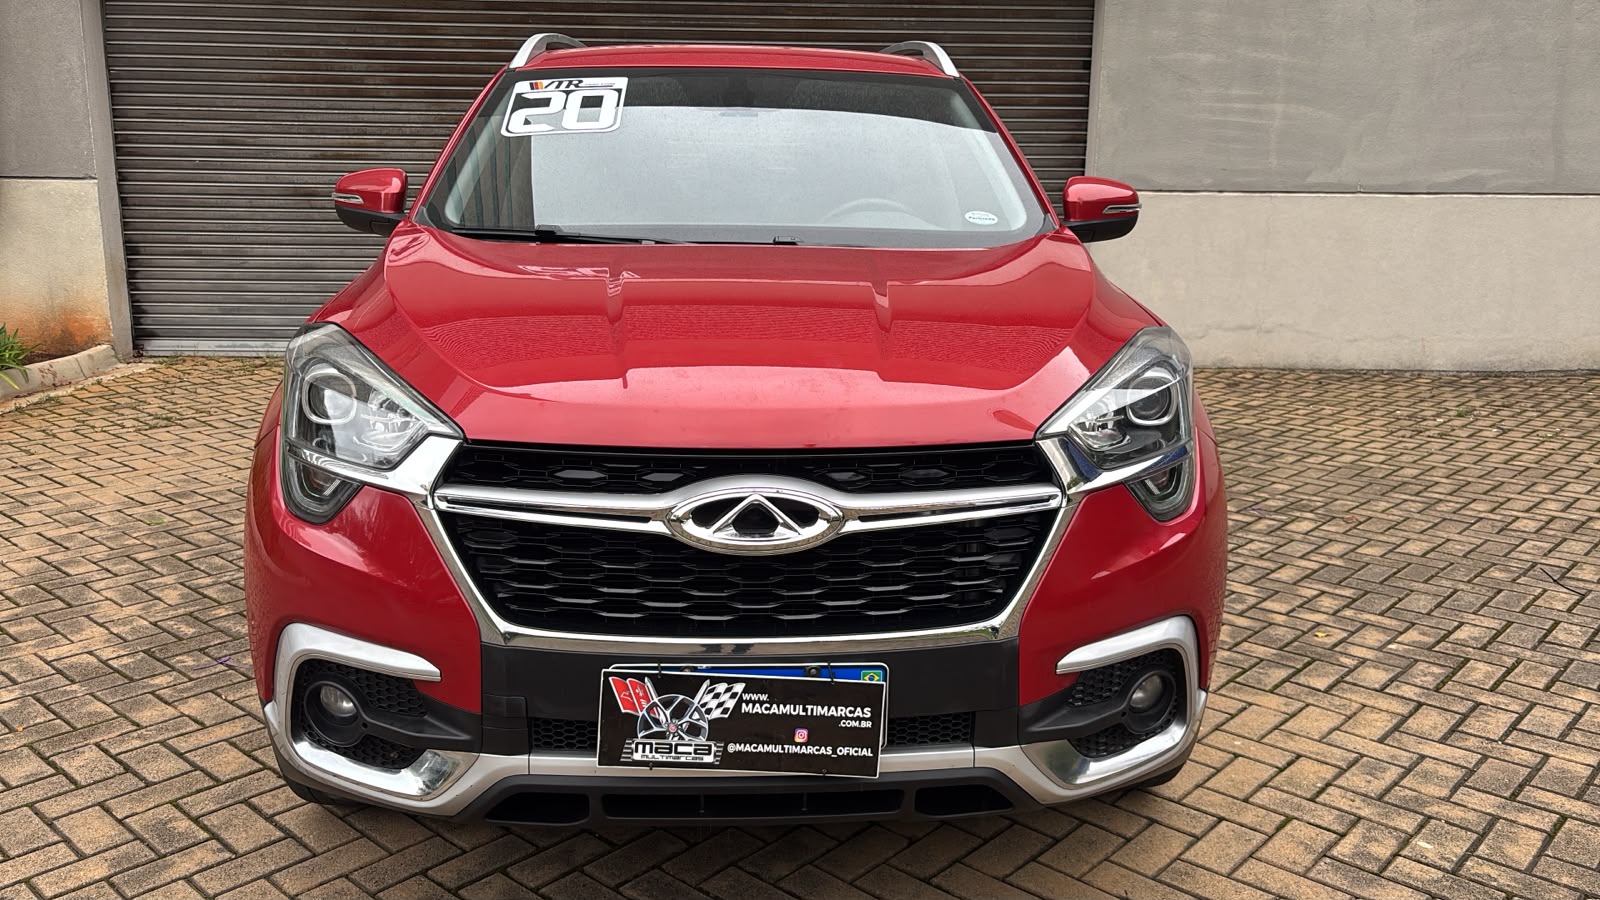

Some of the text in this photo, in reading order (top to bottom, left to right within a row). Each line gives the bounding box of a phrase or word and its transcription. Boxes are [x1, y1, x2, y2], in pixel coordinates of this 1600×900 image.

[508, 89, 618, 133] 20
[741, 703, 872, 718] MACAMULTIMARCAS
[838, 720, 872, 728] .COM.BR
[727, 743, 873, 757] @MACAMULTIMARCAS_OFICIAL
